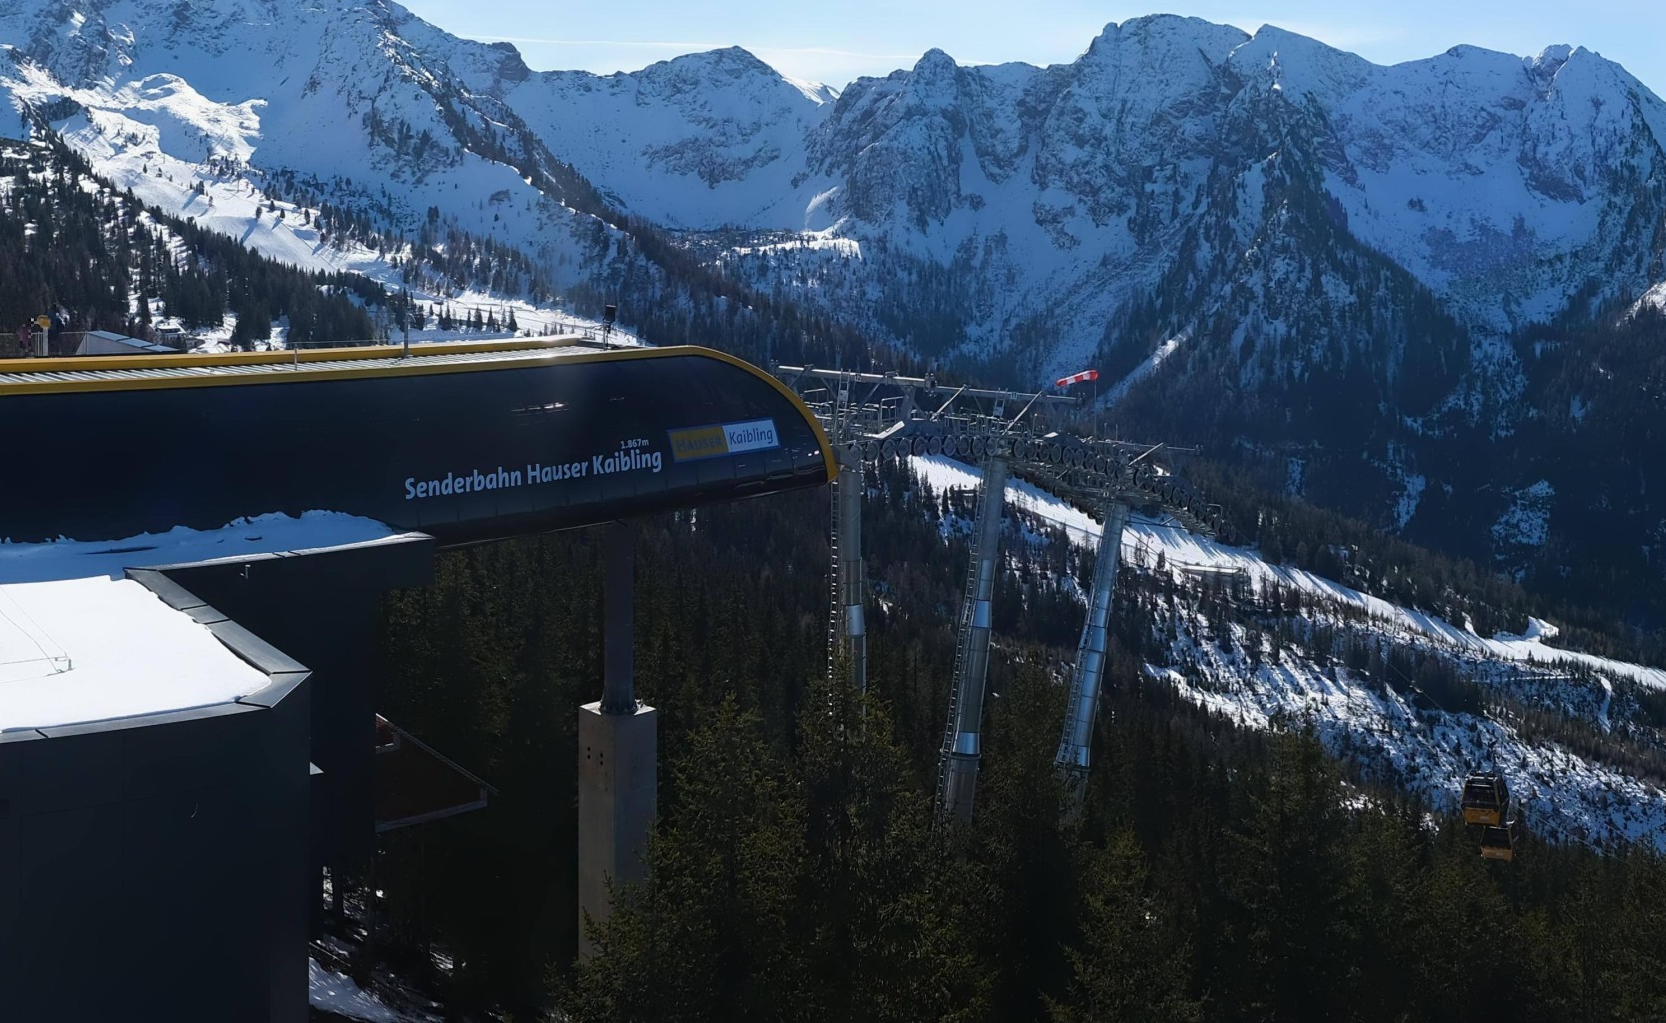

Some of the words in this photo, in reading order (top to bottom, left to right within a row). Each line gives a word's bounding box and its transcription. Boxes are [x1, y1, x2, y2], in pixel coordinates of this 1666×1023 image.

[729, 427, 774, 446] Kaibling
[404, 466, 521, 500] Senderbahn
[527, 461, 589, 486] Hauser
[592, 450, 663, 476] Kaibling
